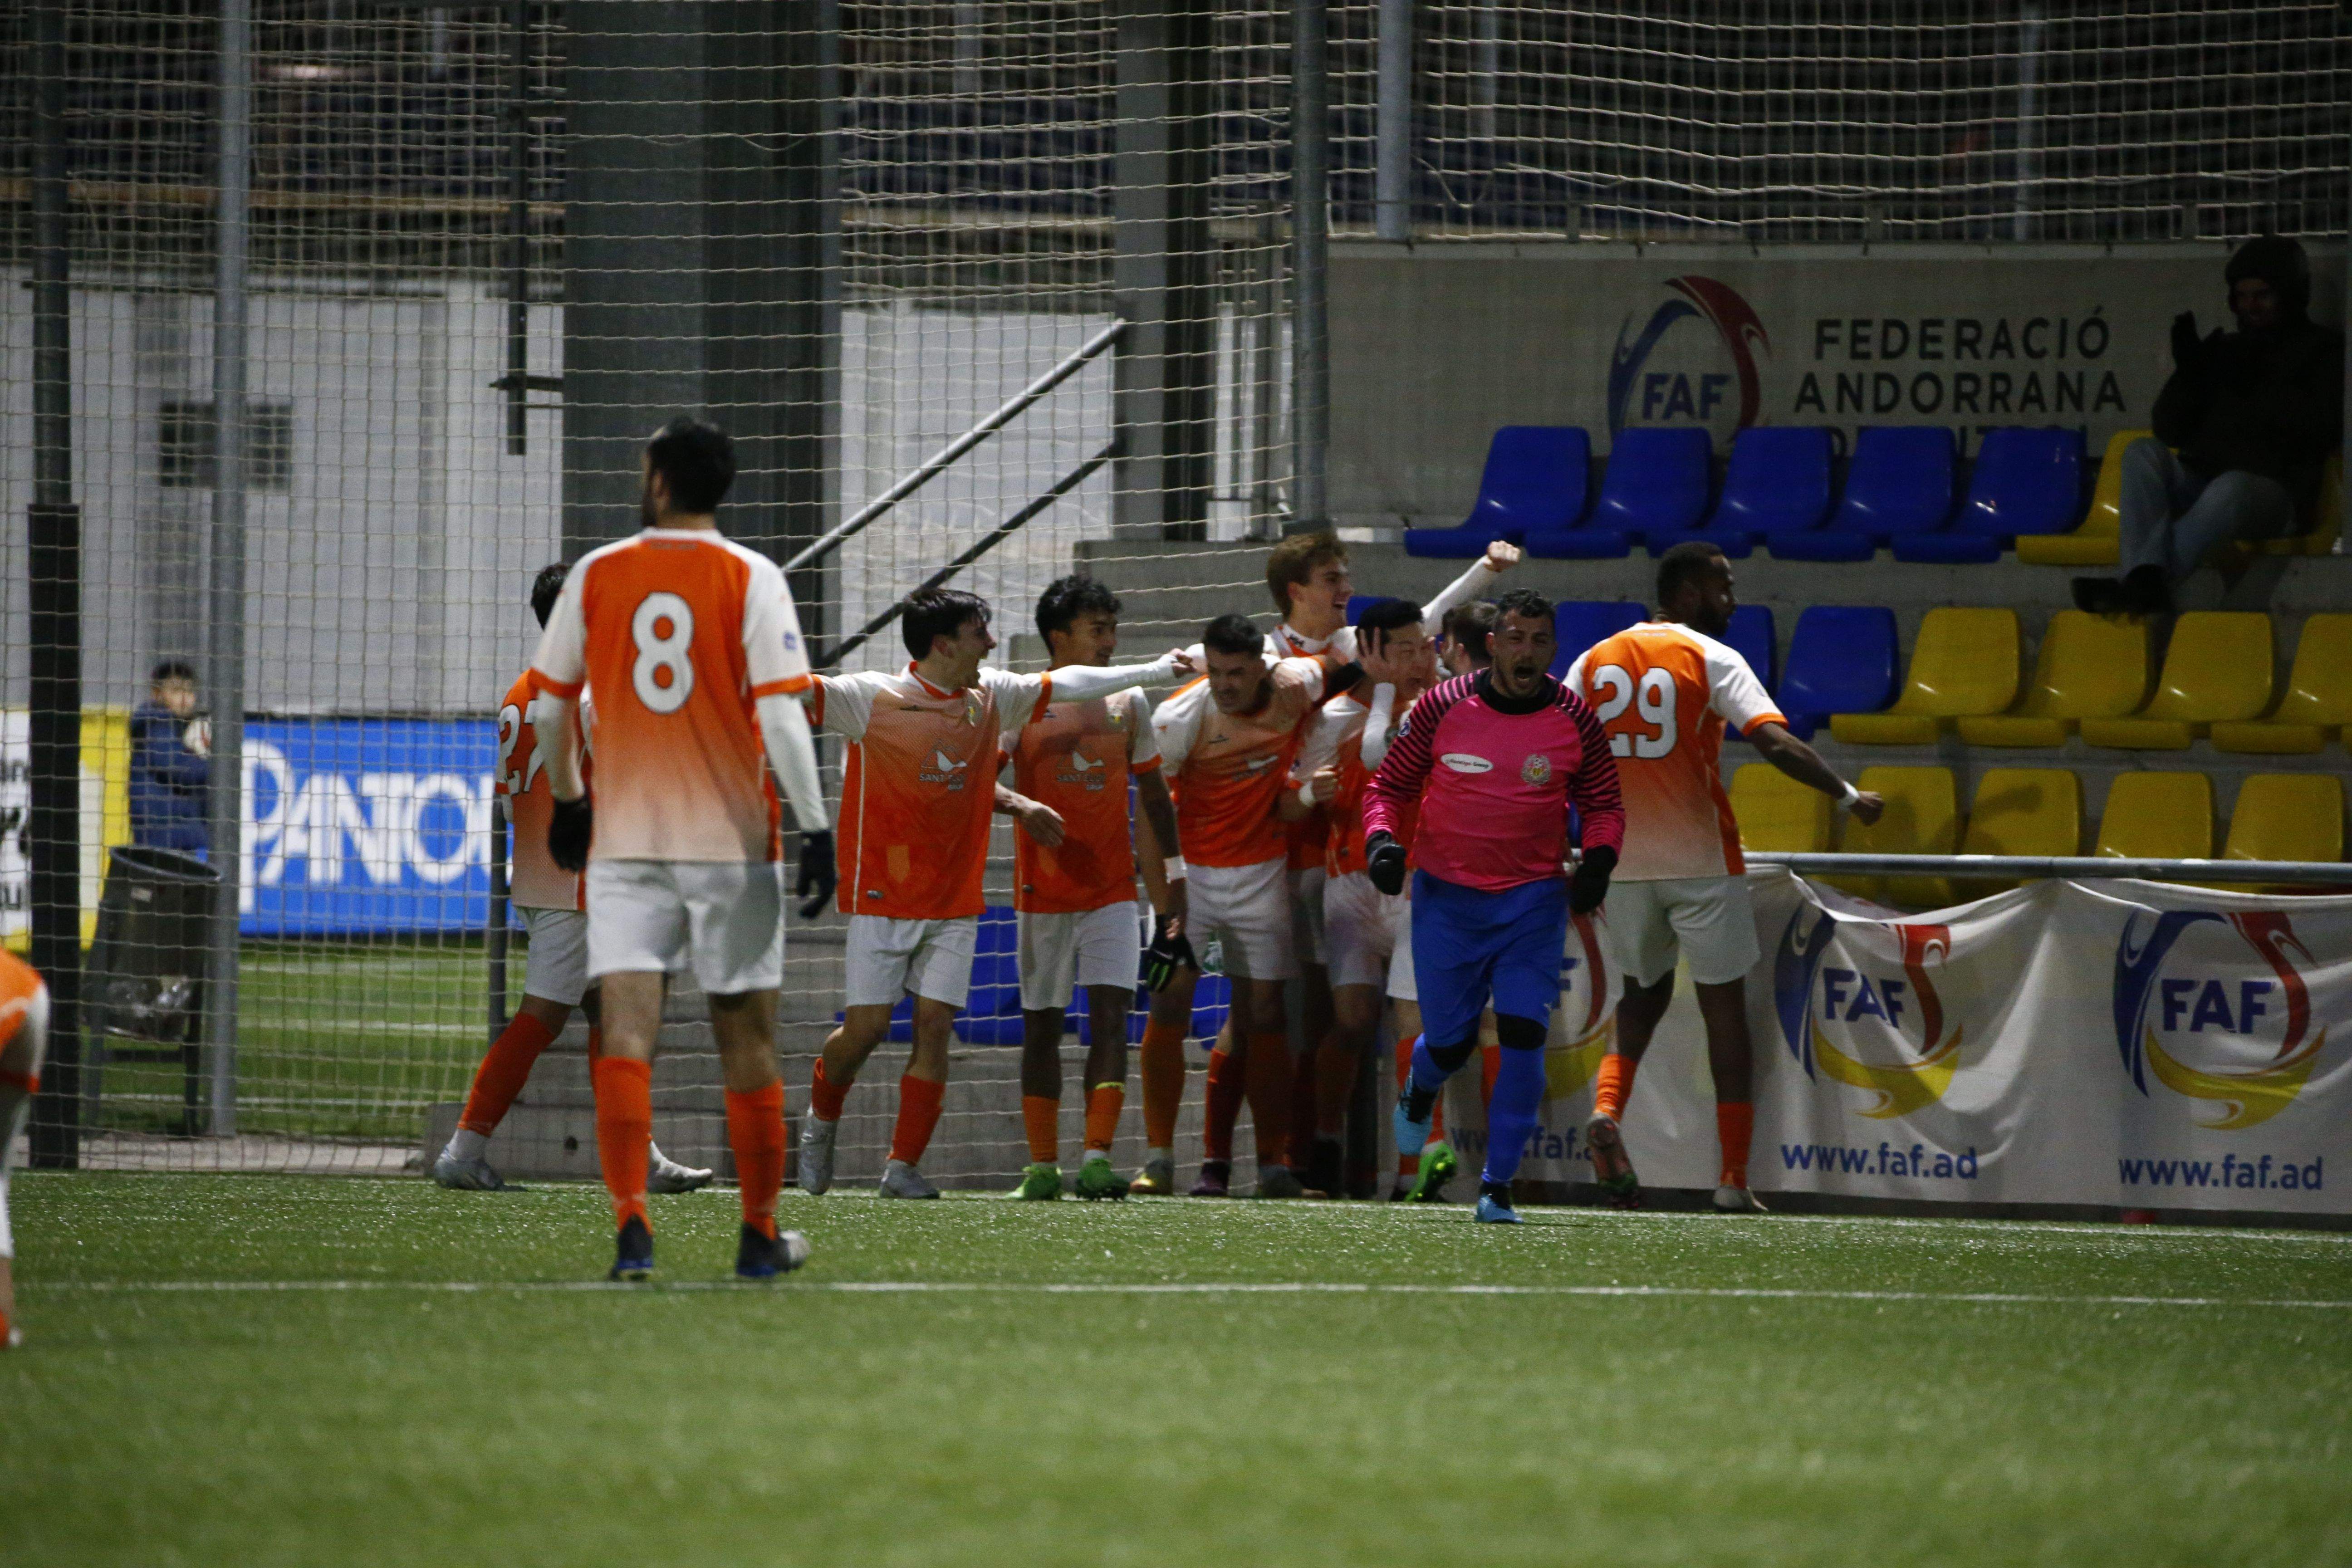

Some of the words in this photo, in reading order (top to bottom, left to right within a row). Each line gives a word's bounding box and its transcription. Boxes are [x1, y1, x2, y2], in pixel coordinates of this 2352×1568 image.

[1815, 305, 2110, 360] FEDERACIÓ
[1641, 373, 1735, 421] FAF
[1794, 370, 2127, 414] ANDORRANA
[632, 591, 695, 715] 8
[1593, 665, 1677, 759] 29
[1823, 967, 1904, 1029] FAF
[2161, 979, 2277, 1034] FAF
[1781, 1142, 1979, 1179] www.faf.ad
[2118, 1153, 2323, 1190] www.faf.ad
